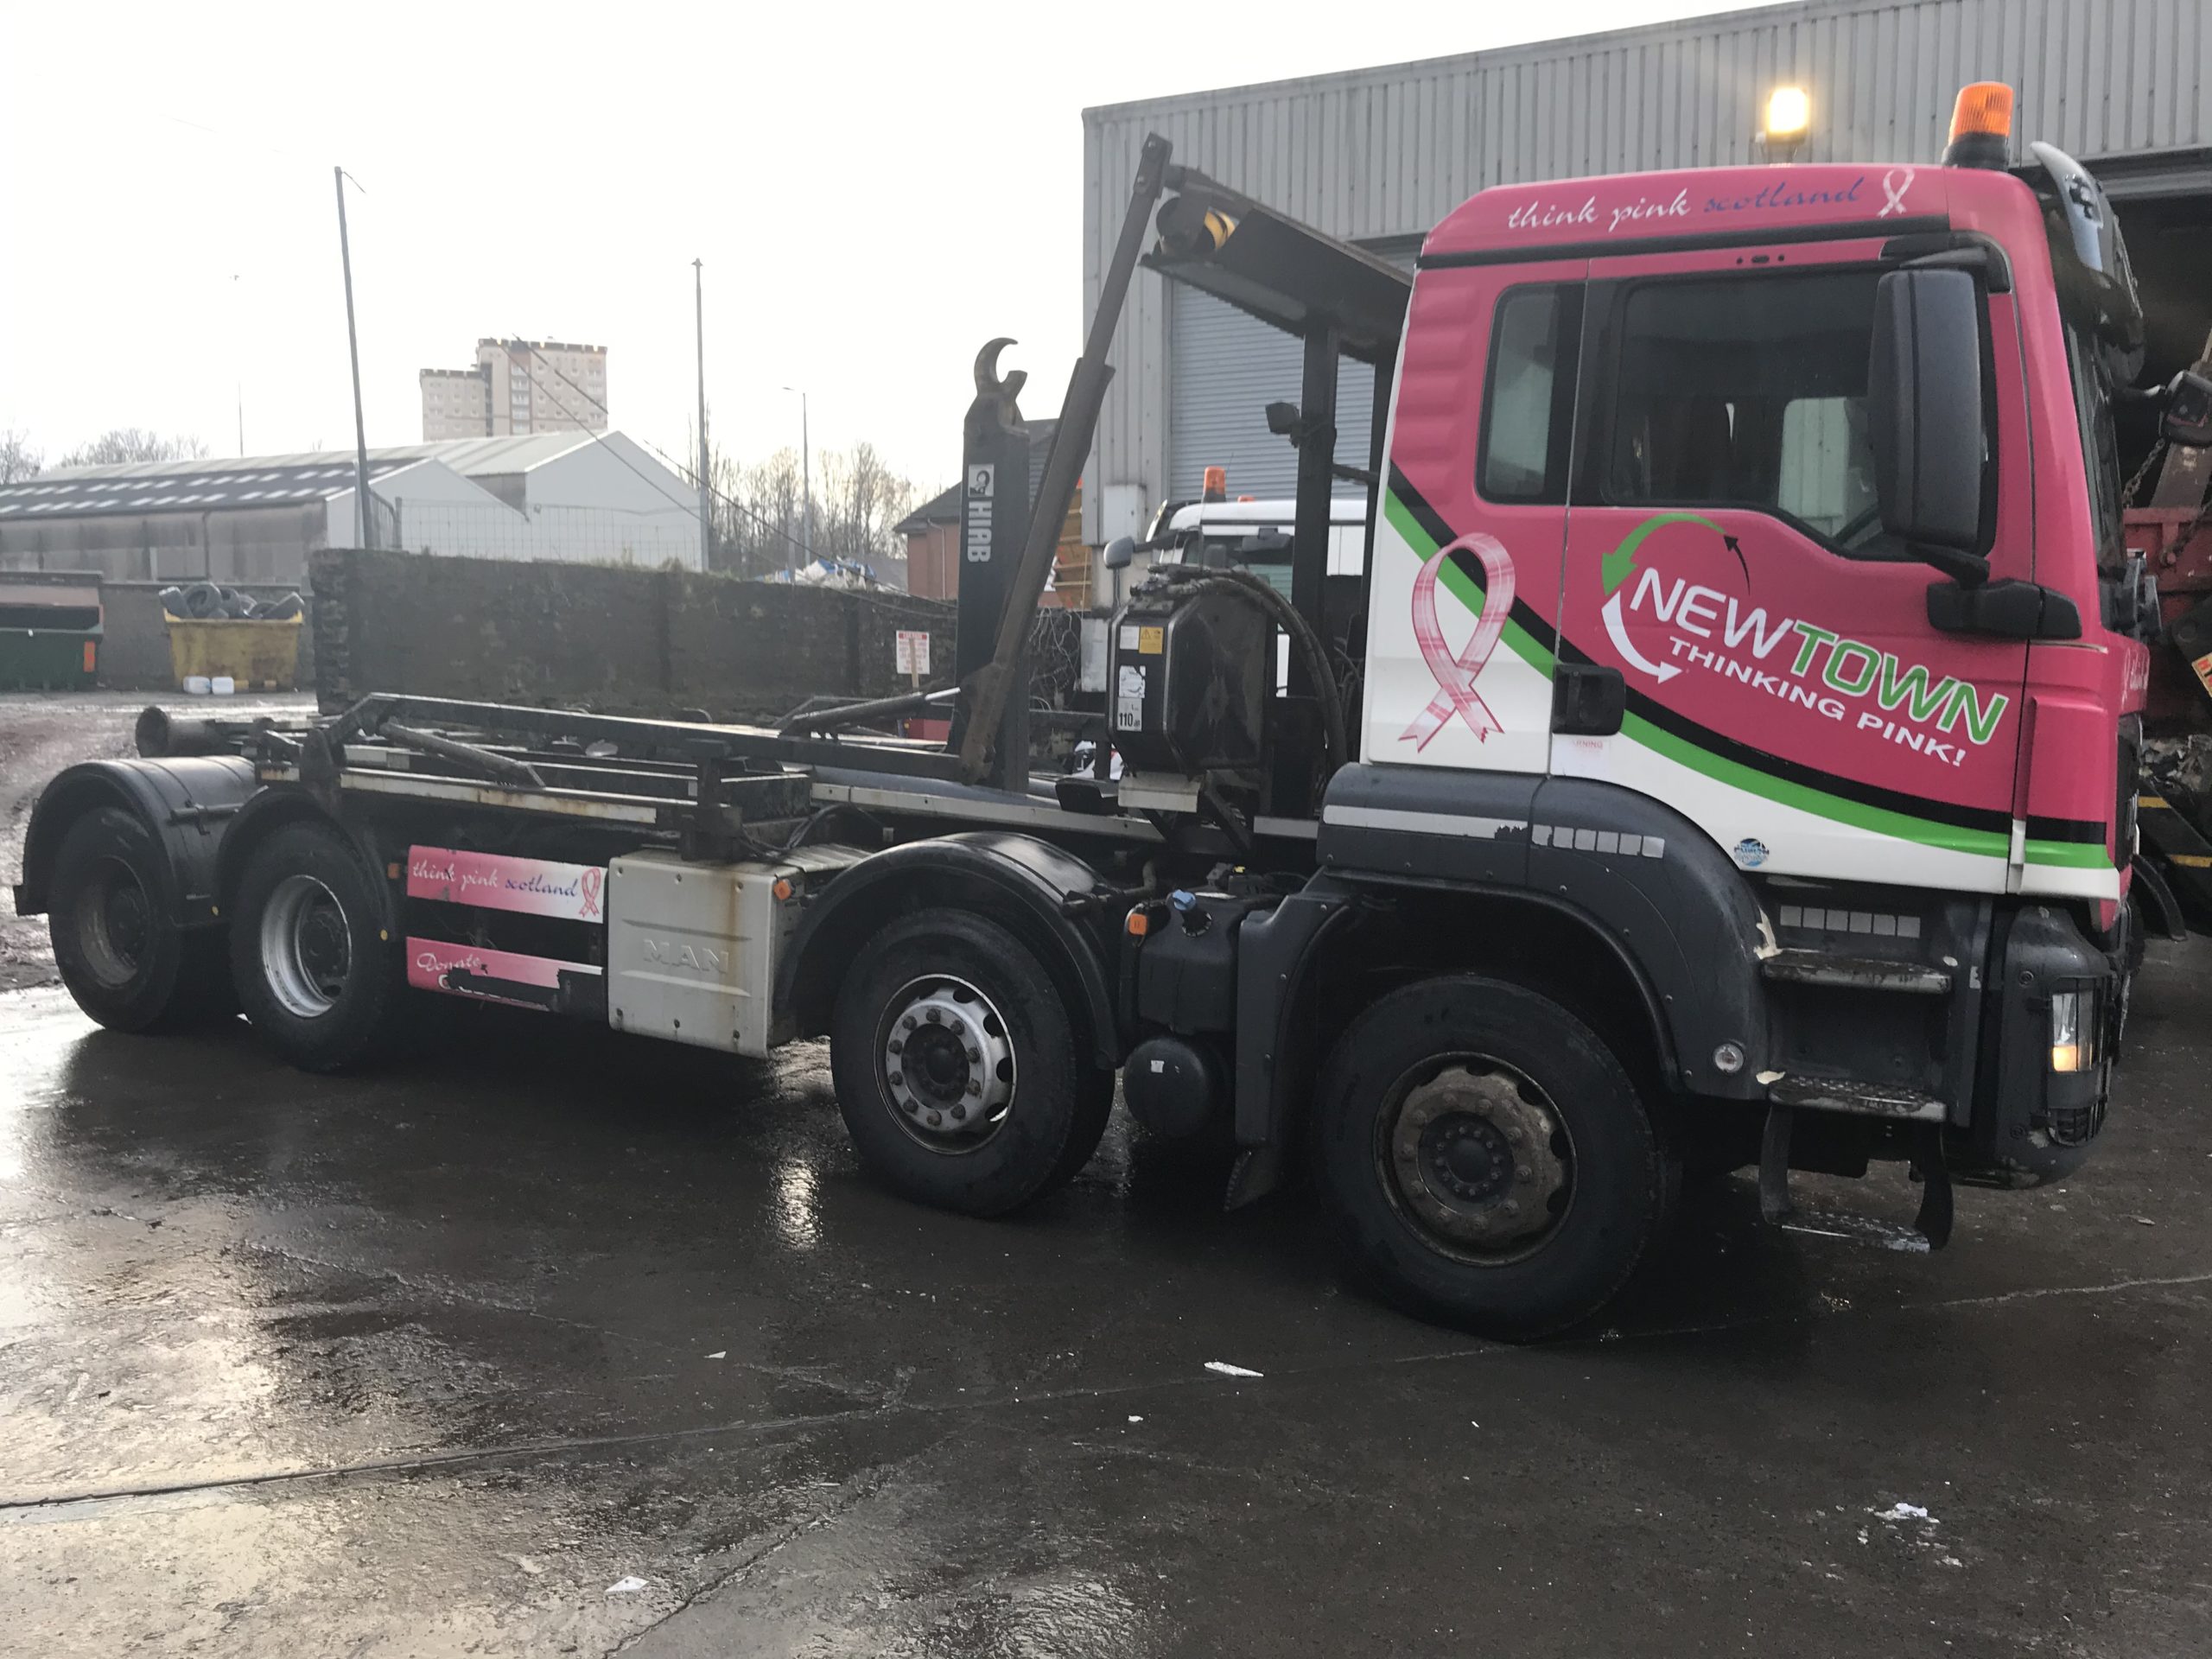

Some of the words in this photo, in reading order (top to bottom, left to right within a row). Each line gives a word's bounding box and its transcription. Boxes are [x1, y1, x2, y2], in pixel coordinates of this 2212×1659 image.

[1509, 196, 1599, 229] think
[1610, 188, 1691, 232] pink
[1704, 177, 1865, 212] scotland
[968, 500, 992, 562] HIAB
[1119, 712, 1133, 727] 110
[1669, 637, 1844, 721] THINKING
[1857, 712, 1967, 767] PINK!
[413, 860, 455, 881] think
[461, 869, 499, 892] pink
[505, 874, 578, 897] scotland
[416, 953, 480, 972] Donate
[643, 939, 728, 975] MAN
